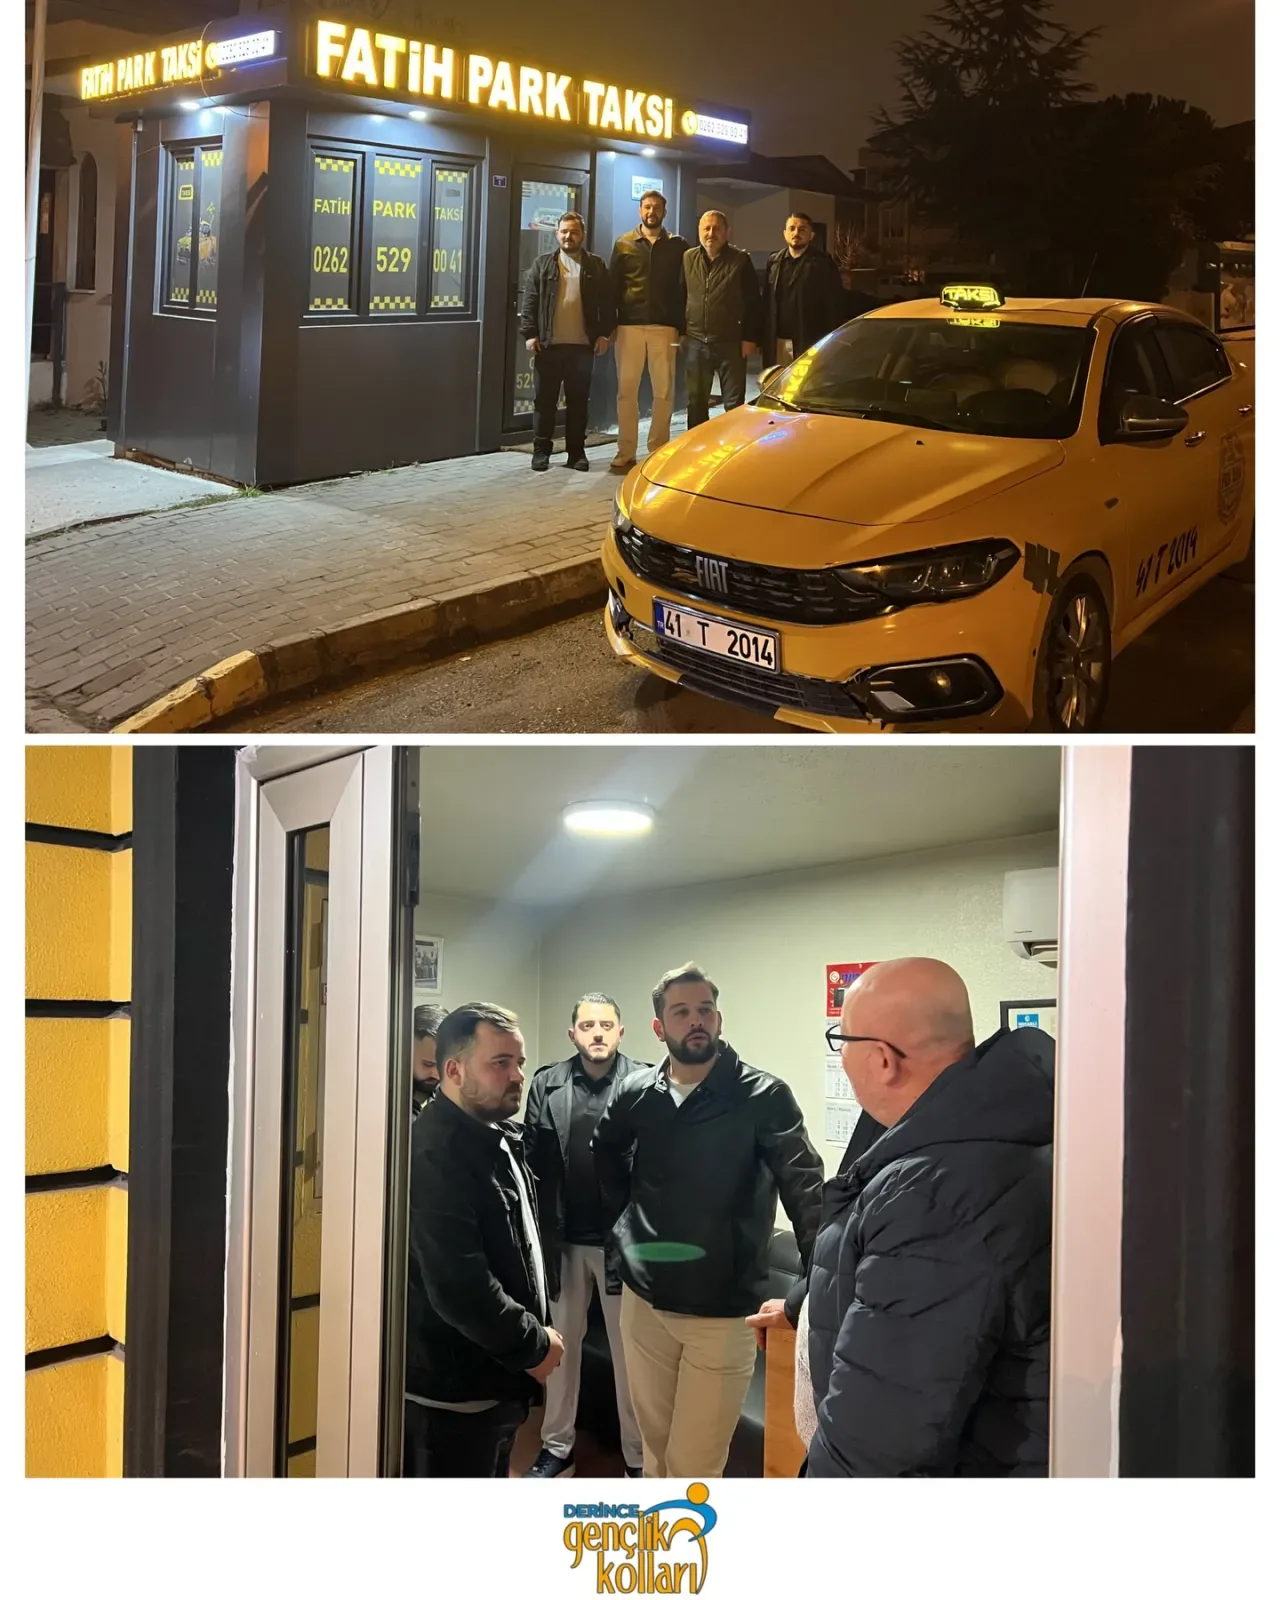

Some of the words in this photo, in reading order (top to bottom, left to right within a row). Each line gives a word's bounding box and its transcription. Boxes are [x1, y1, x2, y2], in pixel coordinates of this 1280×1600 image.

[117, 51, 156, 92] PARK
[468, 54, 572, 121] PARK
[313, 198, 351, 215] FATİH
[372, 200, 416, 219] PARK
[313, 246, 348, 273] 0262
[376, 247, 412, 273] 529
[433, 249, 447, 273] 00
[449, 249, 462, 273] 41
[695, 555, 728, 593] FIAT
[1155, 544, 1169, 585] T
[665, 610, 682, 638] 41
[697, 621, 709, 646] T
[727, 630, 773, 666] 2014
